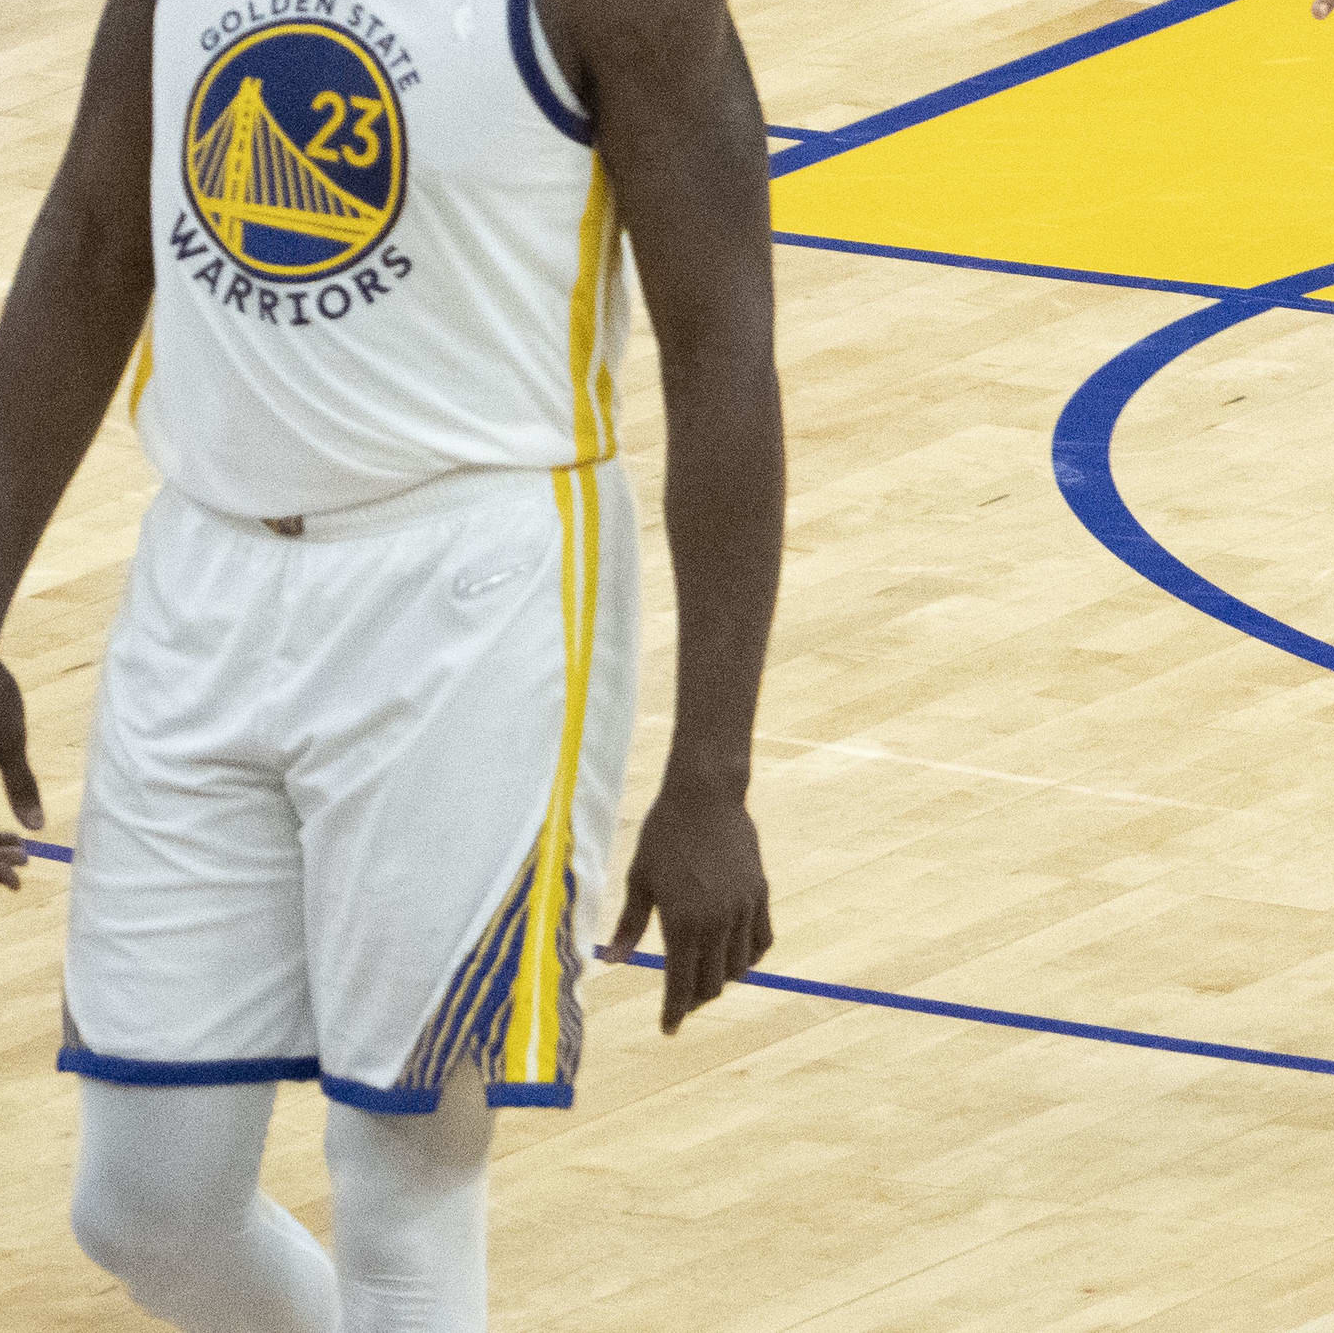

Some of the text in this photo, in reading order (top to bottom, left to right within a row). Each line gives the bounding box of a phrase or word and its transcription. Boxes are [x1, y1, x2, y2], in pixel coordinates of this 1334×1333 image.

[347, 4, 421, 91] STATE
[305, 90, 387, 168] 23
[169, 211, 414, 327] WARRIORS
